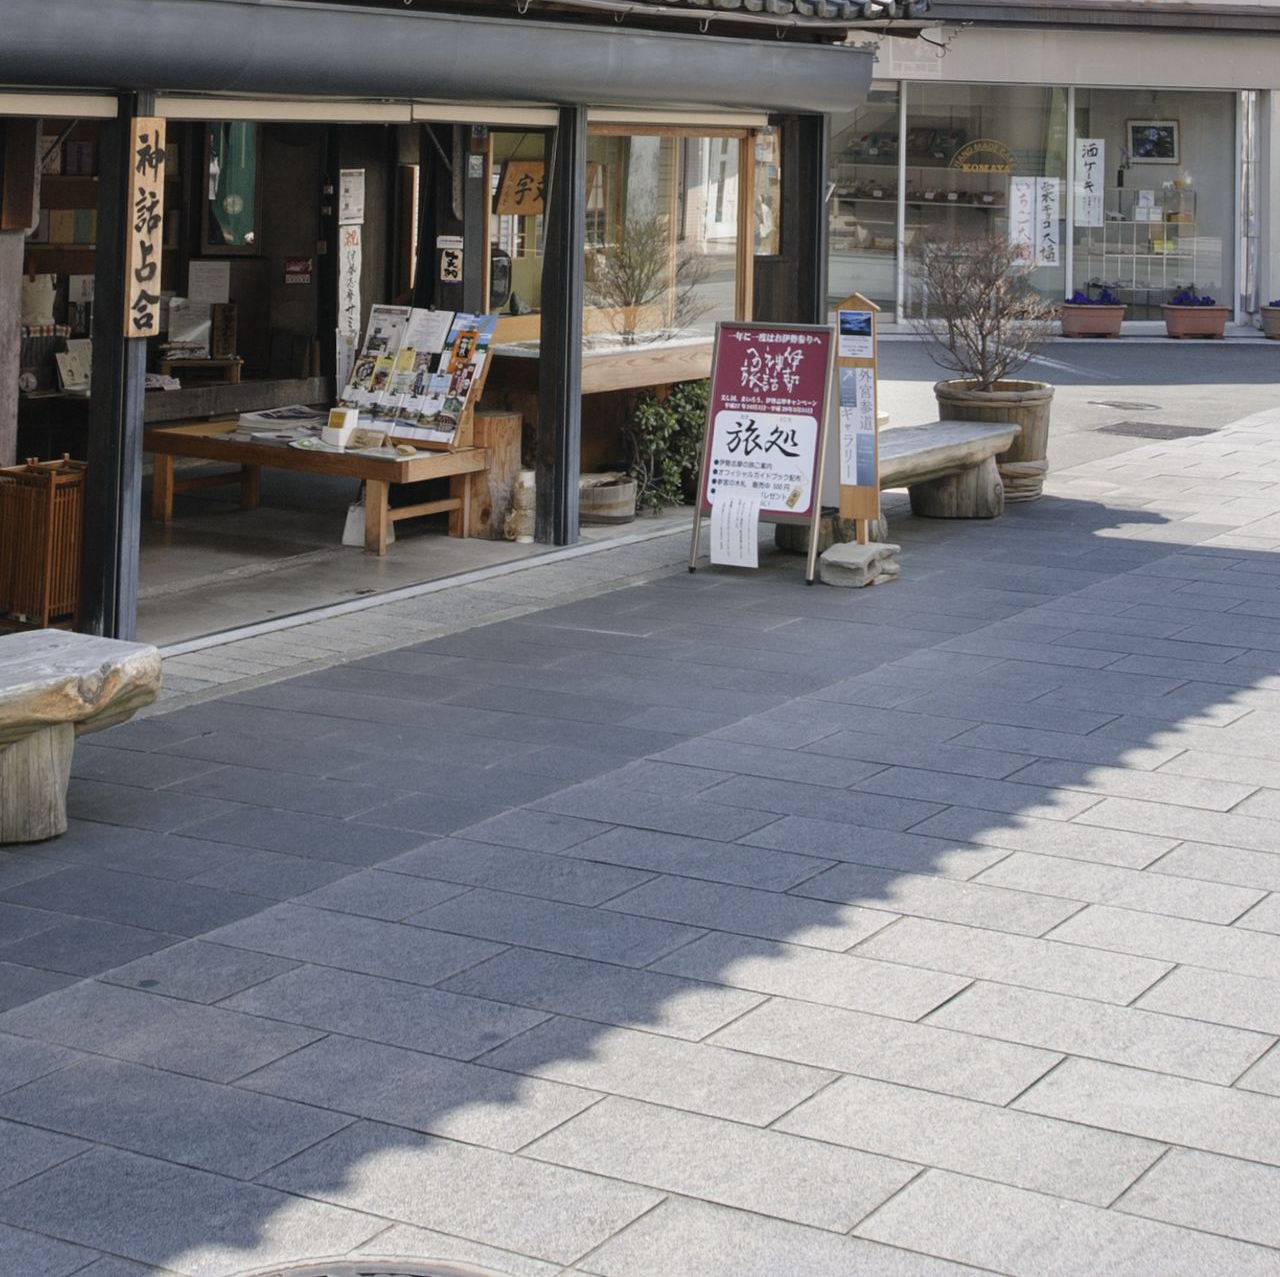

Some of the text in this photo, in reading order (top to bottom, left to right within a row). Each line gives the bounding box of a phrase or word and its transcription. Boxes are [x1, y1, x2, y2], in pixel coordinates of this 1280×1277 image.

[1081, 142, 1099, 194] 酒ケーキ
[133, 129, 167, 333] 神話占合
[858, 368, 873, 431] 外宮参道
[725, 418, 802, 458] 旅処
[841, 406, 855, 479] ギャラリー
